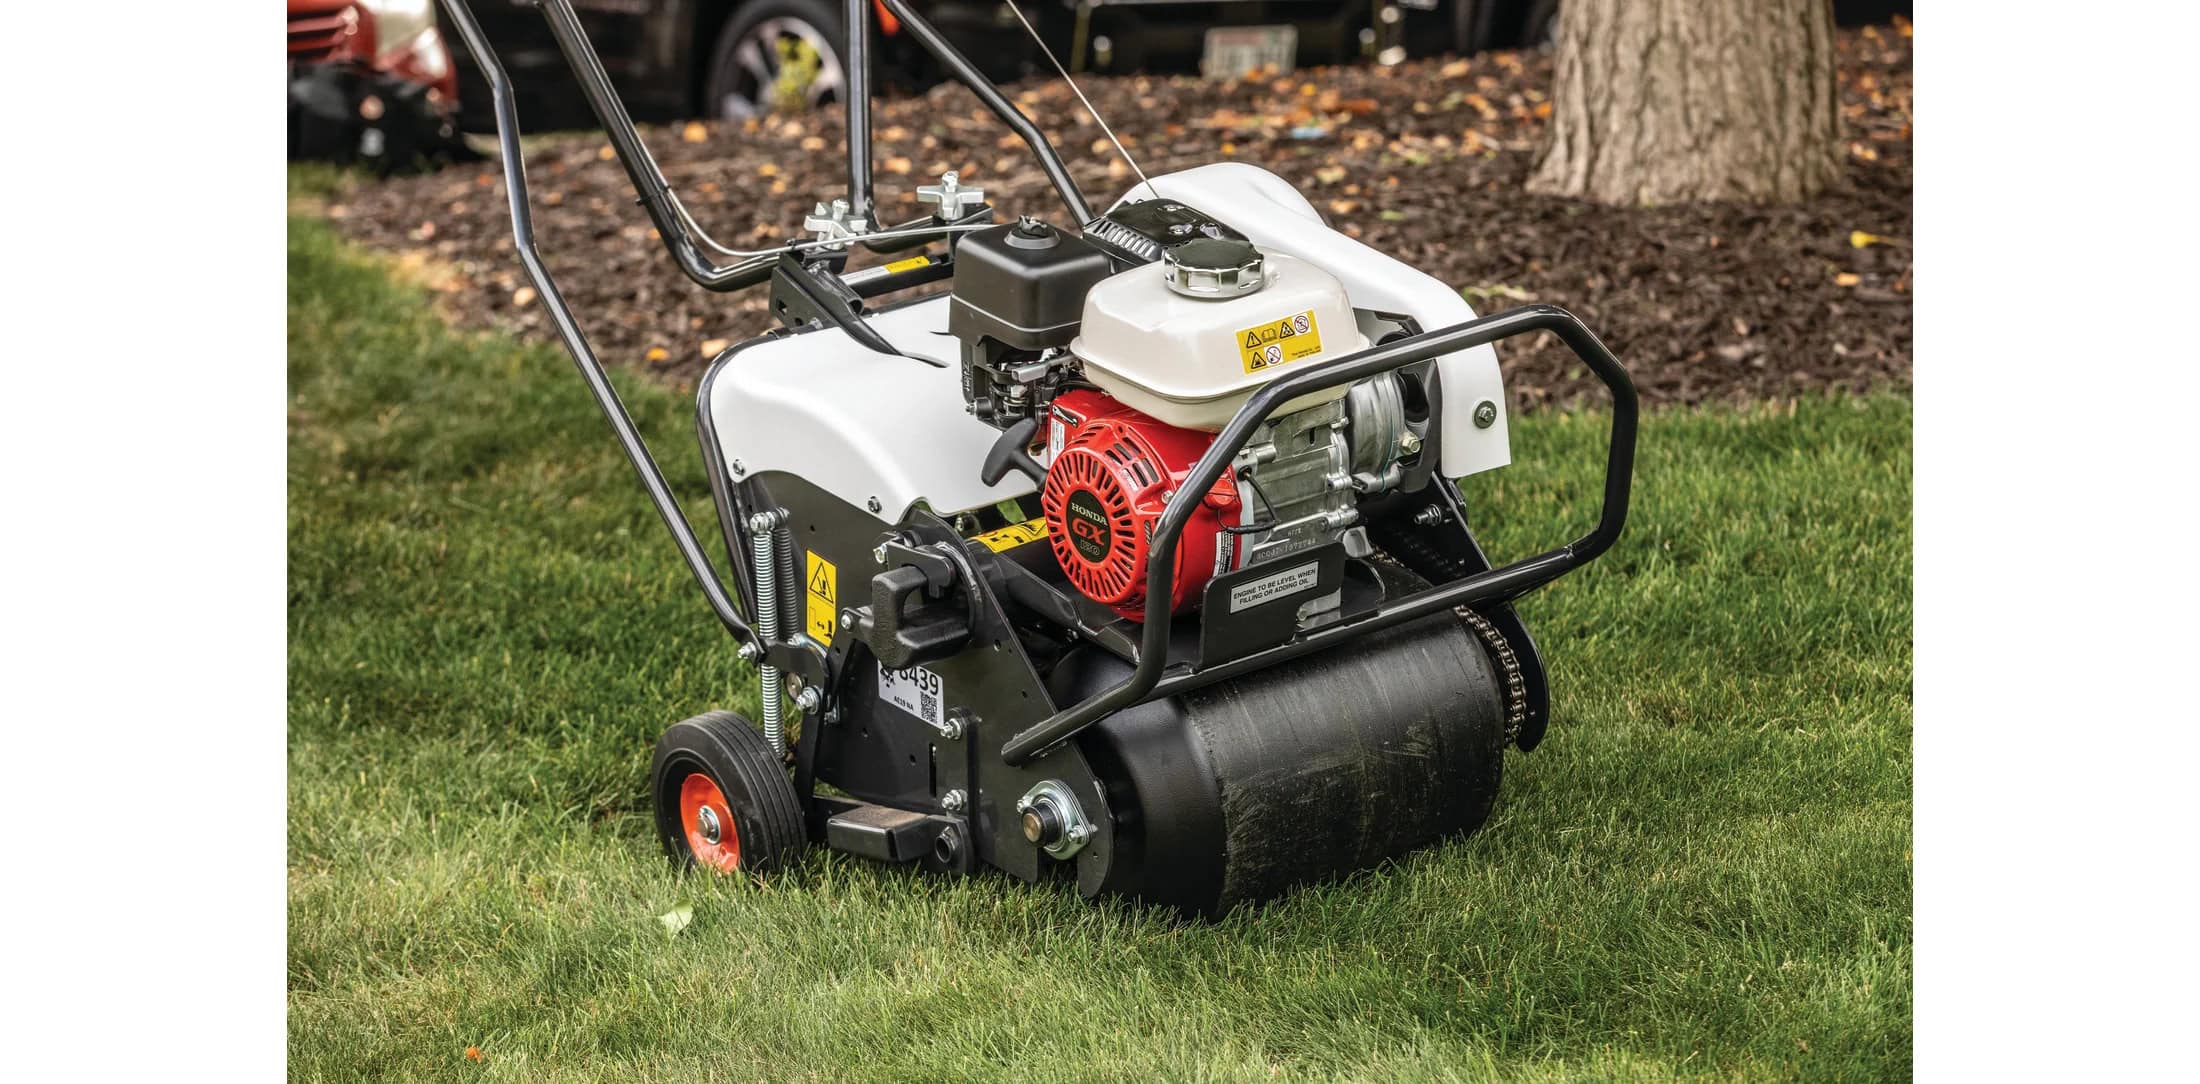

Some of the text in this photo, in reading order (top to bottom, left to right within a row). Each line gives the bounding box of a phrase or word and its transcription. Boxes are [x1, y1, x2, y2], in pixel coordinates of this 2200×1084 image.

[1071, 502, 1108, 526] HONDA
[1072, 518, 1106, 546] GX
[1233, 586, 1257, 600] ENGINE
[1258, 584, 1267, 592] TO
[1267, 580, 1277, 589] BE
[1277, 575, 1297, 586] LEVEL
[1297, 568, 1316, 578] WHEN
[1239, 592, 1263, 605] FILLING
[1263, 589, 1273, 597] OR
[1274, 581, 1298, 593] ADDING
[1298, 578, 1309, 586] OIL
